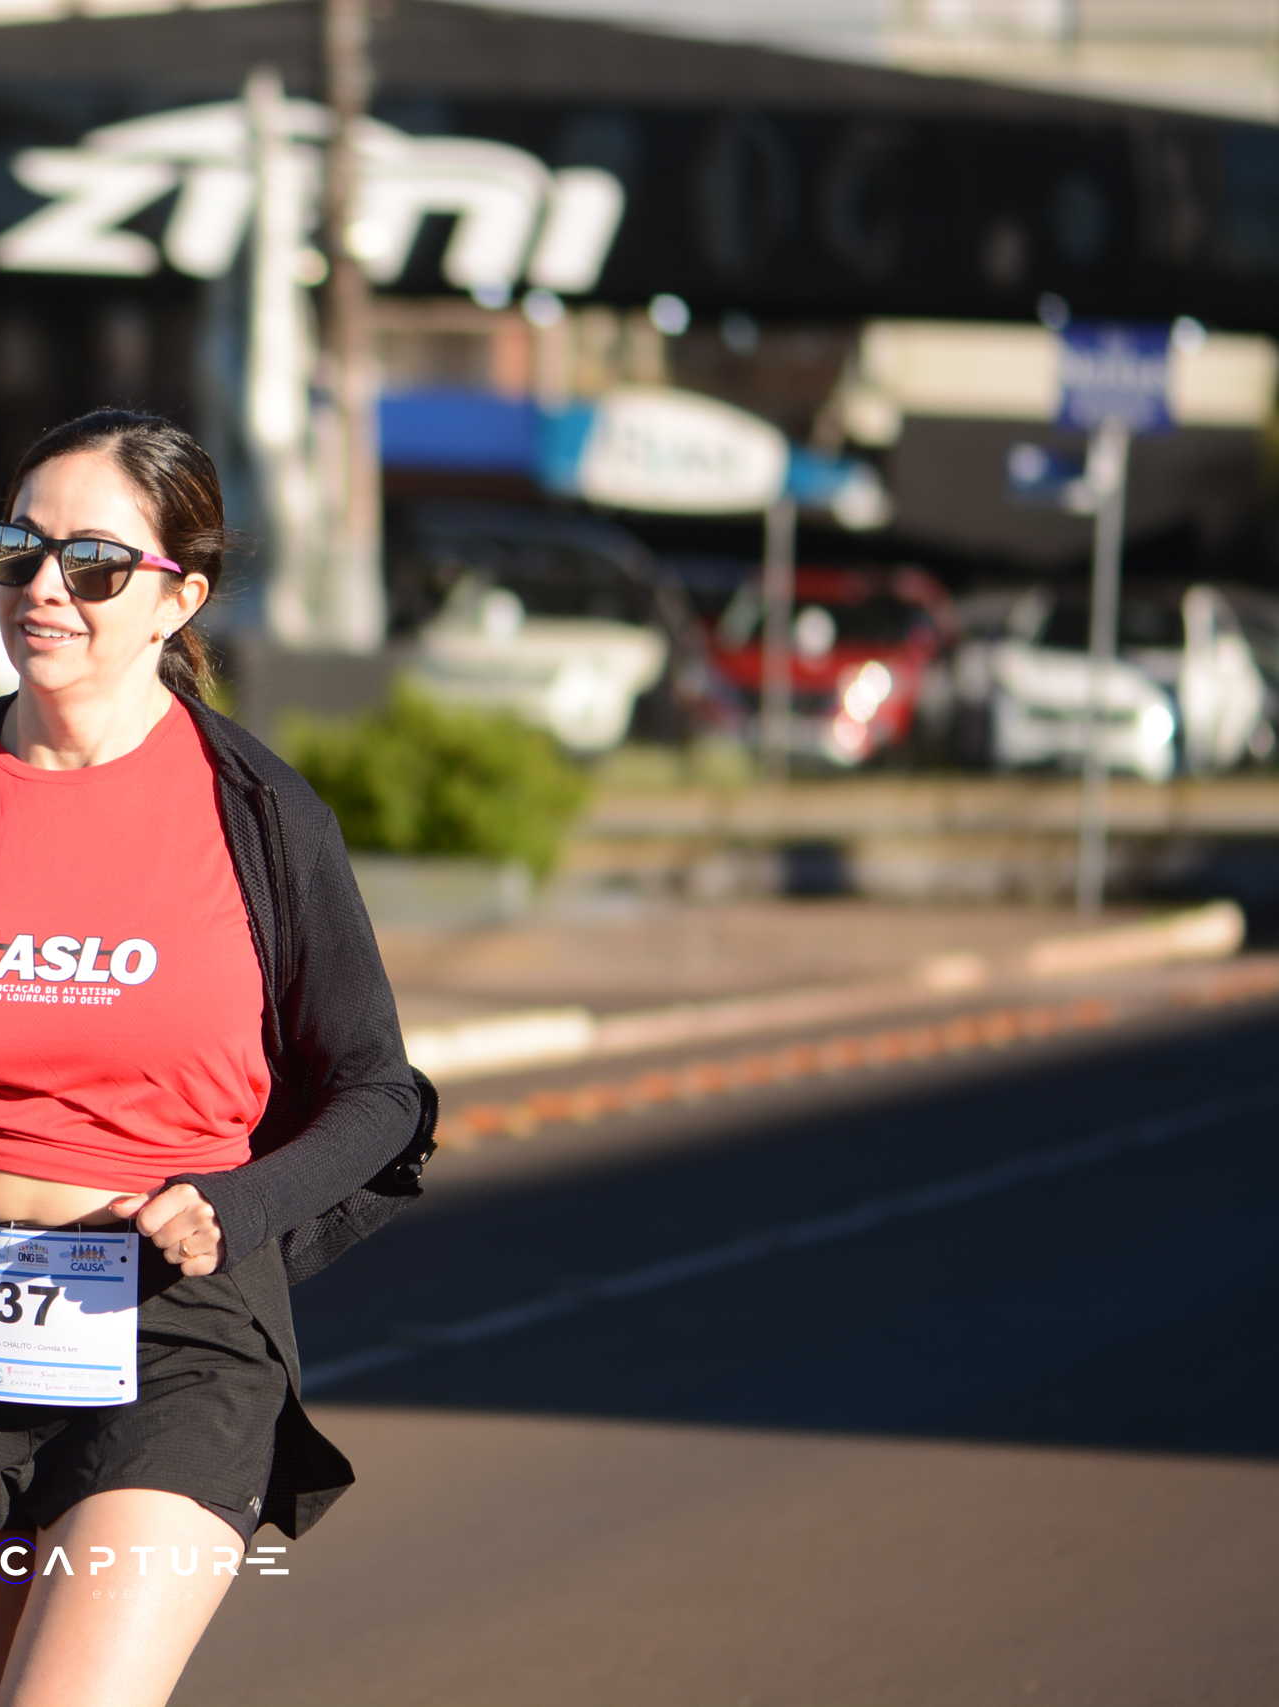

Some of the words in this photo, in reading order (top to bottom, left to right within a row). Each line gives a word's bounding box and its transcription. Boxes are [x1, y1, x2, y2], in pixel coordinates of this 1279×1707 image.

[45, 986, 58, 995] DE
[62, 987, 121, 997] ATLETISMO
[7, 993, 58, 1004] LOURENÇO
[63, 995, 76, 1004] DO
[80, 996, 113, 1005] OESTE
[18, 1252, 35, 1263] ONG
[70, 1262, 105, 1272] CAUSA
[3, 1341, 32, 1350] CHALITO
[38, 1344, 61, 1352] Corrida
